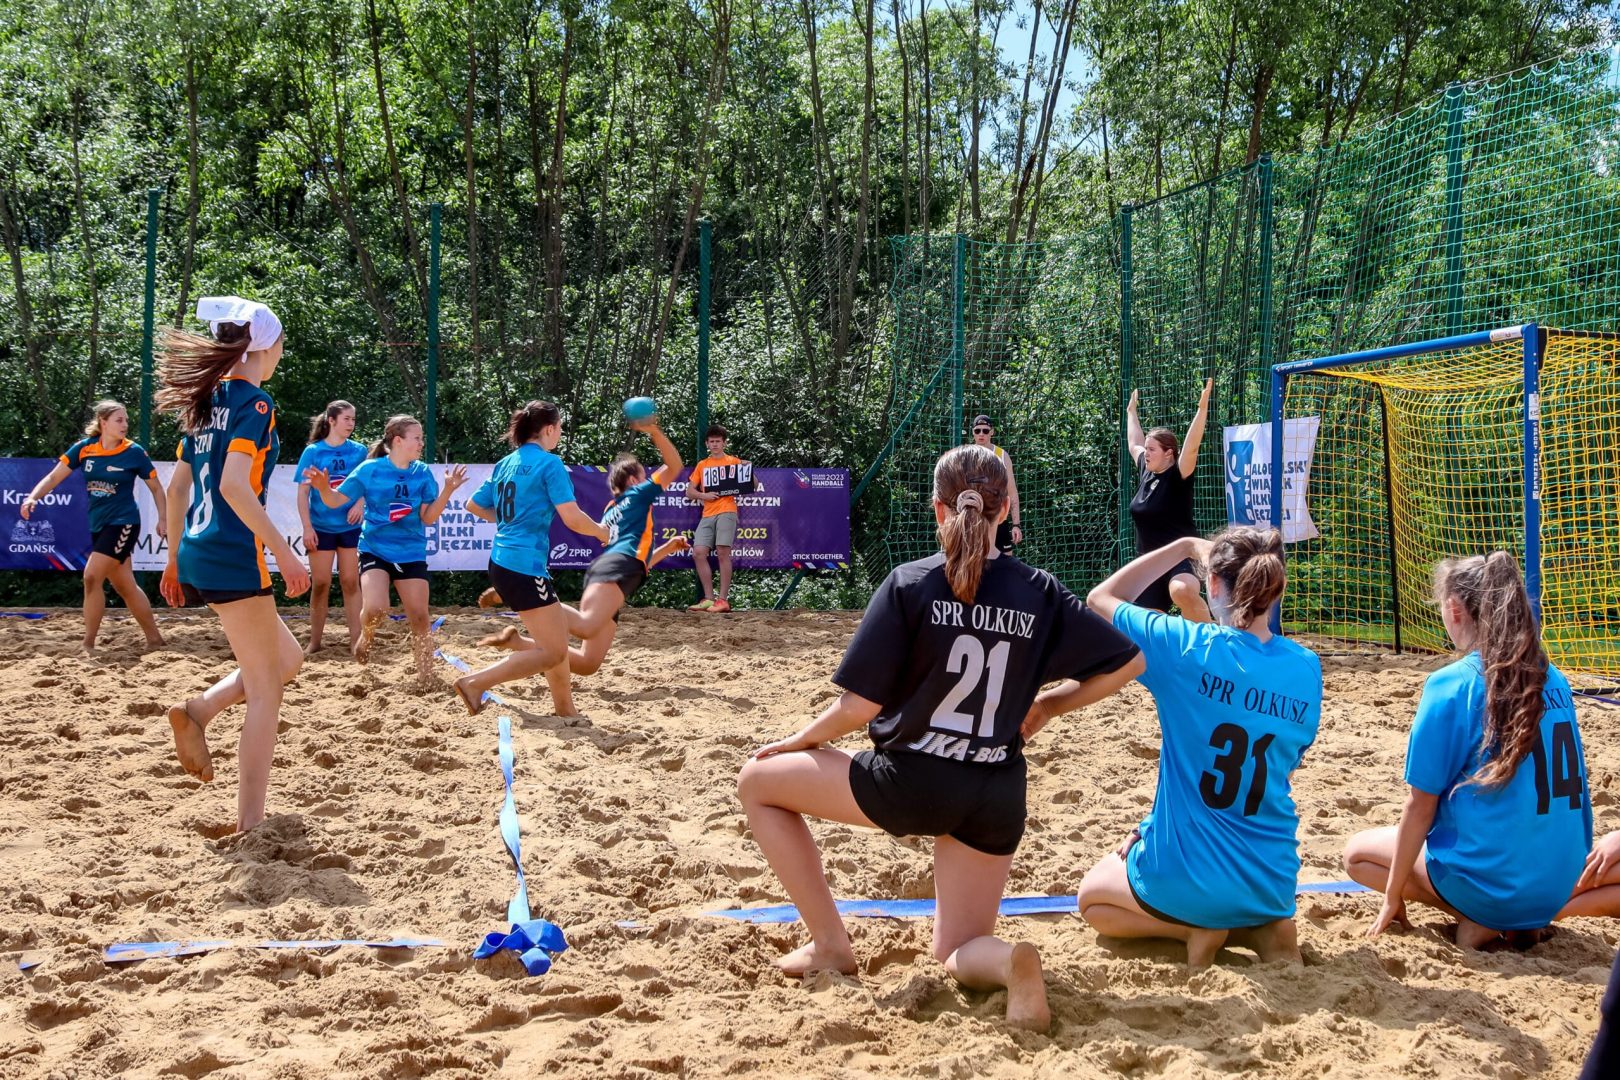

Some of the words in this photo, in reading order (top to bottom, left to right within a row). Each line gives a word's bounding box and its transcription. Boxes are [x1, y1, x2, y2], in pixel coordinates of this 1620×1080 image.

[332, 459, 346, 471] 23
[704, 468, 719, 486] 18
[739, 465, 751, 481] 14
[3, 490, 72, 506] Krów
[394, 484, 409, 498] 24
[497, 480, 516, 525] 18
[734, 495, 780, 507] ŻCZYZN
[662, 528, 677, 539] 22
[736, 528, 767, 539] 2023
[9, 543, 55, 553] GDAŃSK
[425, 540, 492, 552] RĘCZNE
[569, 549, 592, 557] ZPRP
[729, 546, 764, 557] raków
[931, 600, 964, 627] SPR
[971, 604, 1036, 639] OLKUSZ
[929, 634, 1011, 738] 21
[1198, 672, 1235, 705] SPR
[1244, 687, 1309, 725] OLKUSZ
[1198, 723, 1276, 817] 31
[1531, 720, 1583, 816] 14
